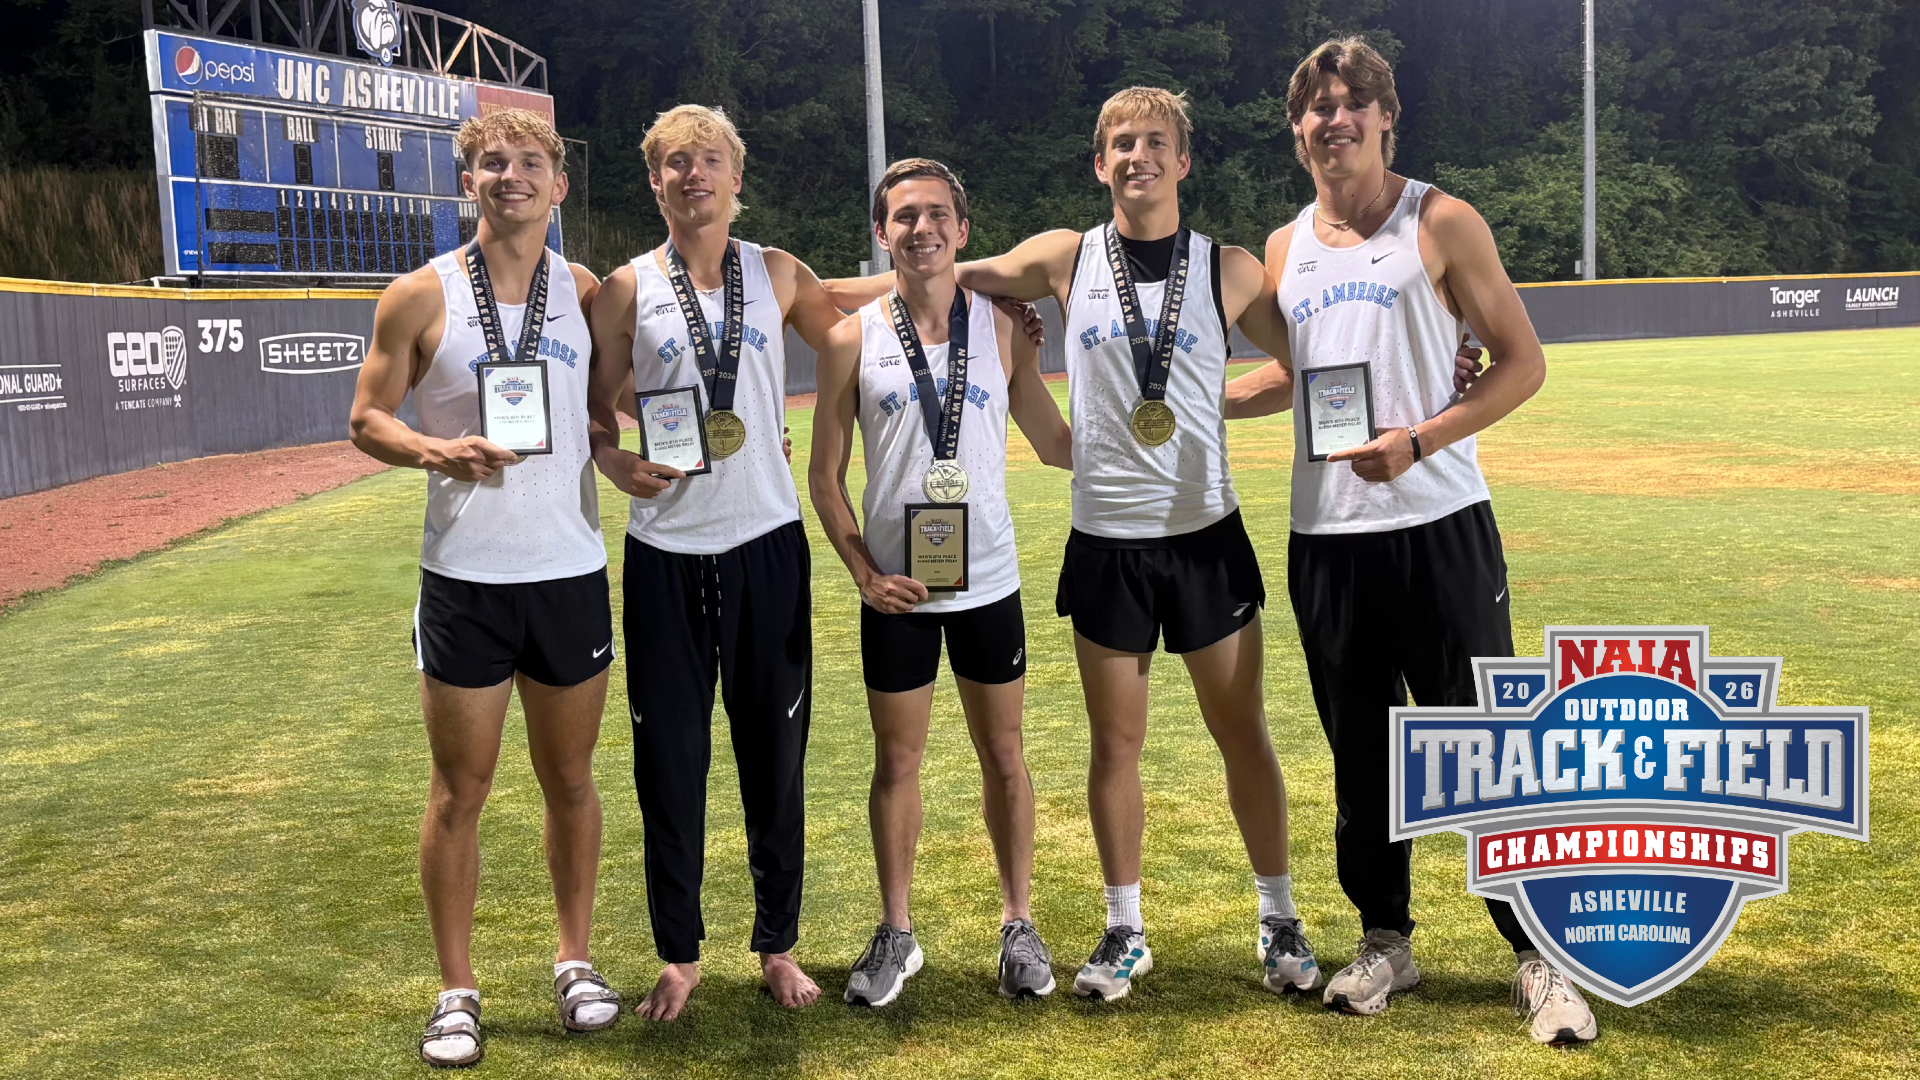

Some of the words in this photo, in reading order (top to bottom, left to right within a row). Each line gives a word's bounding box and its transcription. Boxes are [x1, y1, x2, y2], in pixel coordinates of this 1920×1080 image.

[204, 61, 255, 84] pepsi
[278, 58, 330, 104] UNC
[342, 68, 460, 120] ASHEVILLE
[214, 108, 237, 134] BAT
[287, 116, 315, 142] BALL
[365, 126, 402, 152] STRIKE
[280, 190, 286, 206] 1
[297, 190, 304, 207] 2
[314, 192, 320, 208] 3
[330, 193, 337, 209] 4
[348, 194, 354, 210] 5
[363, 195, 369, 211] 6
[378, 196, 383, 212] 7
[408, 199, 414, 214] 9
[422, 200, 430, 214] 10
[1292, 298, 1319, 323] ST.
[1322, 282, 1399, 309] AMBROSE
[1770, 287, 1821, 308] Tanger
[1846, 287, 1899, 302] LAUNCH
[525, 264, 548, 362] LL-AMERICAN
[729, 256, 742, 358] ALL-AMERICAN
[1160, 258, 1188, 369] ALL-AMERICAN
[1771, 308, 1820, 318] ASHEVILLE
[197, 319, 244, 353] 375
[1080, 326, 1106, 350] ST.
[1131, 336, 1149, 345] 2026
[268, 342, 360, 364] SHEETZ
[658, 337, 686, 363] ST.
[24, 373, 56, 393] GUARD
[118, 376, 166, 392] SURFACES
[702, 368, 718, 377] 202
[718, 372, 736, 380] 2026
[914, 368, 931, 377] 2026
[1149, 382, 1166, 391] 2026
[116, 402, 119, 411] A
[121, 399, 146, 410] TENCATE
[147, 397, 172, 408] COMPANY
[879, 391, 907, 417] ST.
[946, 348, 966, 458] ALL-AMERICAN
